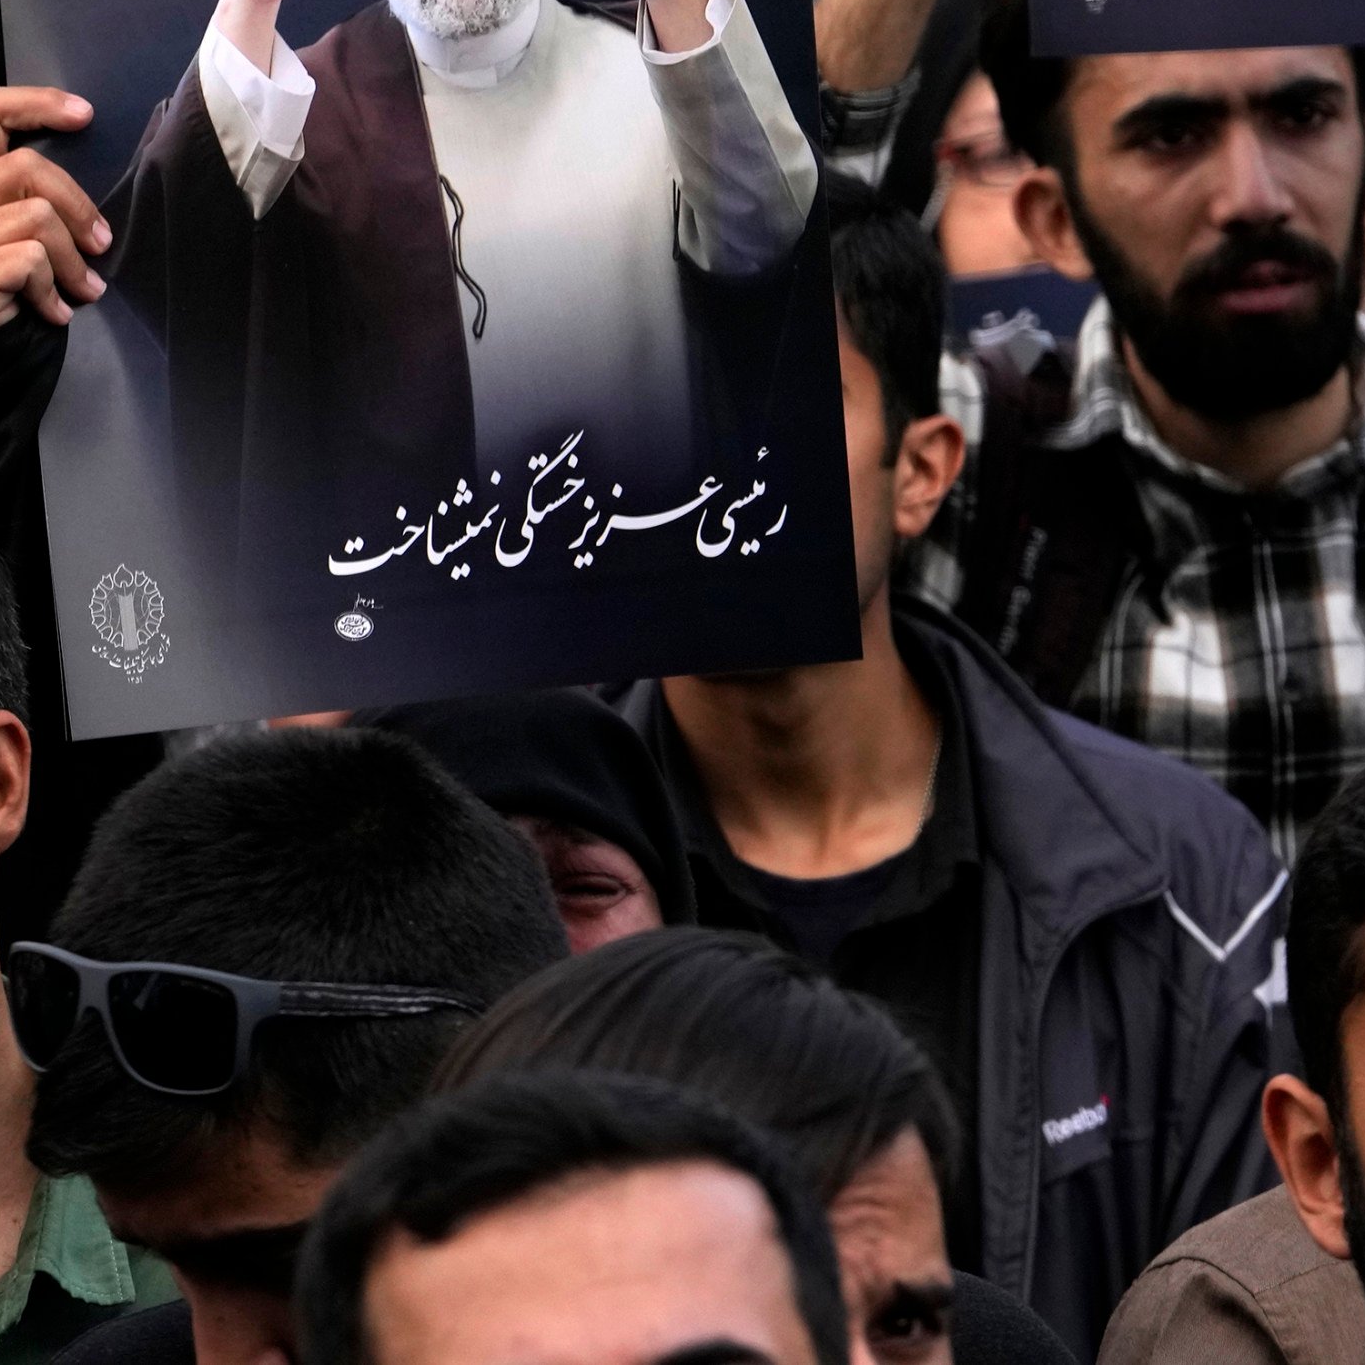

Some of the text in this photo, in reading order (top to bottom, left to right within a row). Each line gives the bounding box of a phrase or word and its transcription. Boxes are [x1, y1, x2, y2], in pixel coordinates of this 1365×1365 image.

[495, 429, 586, 568] خستگی
[568, 475, 723, 569] عزیز
[696, 446, 787, 558] رئیسی
